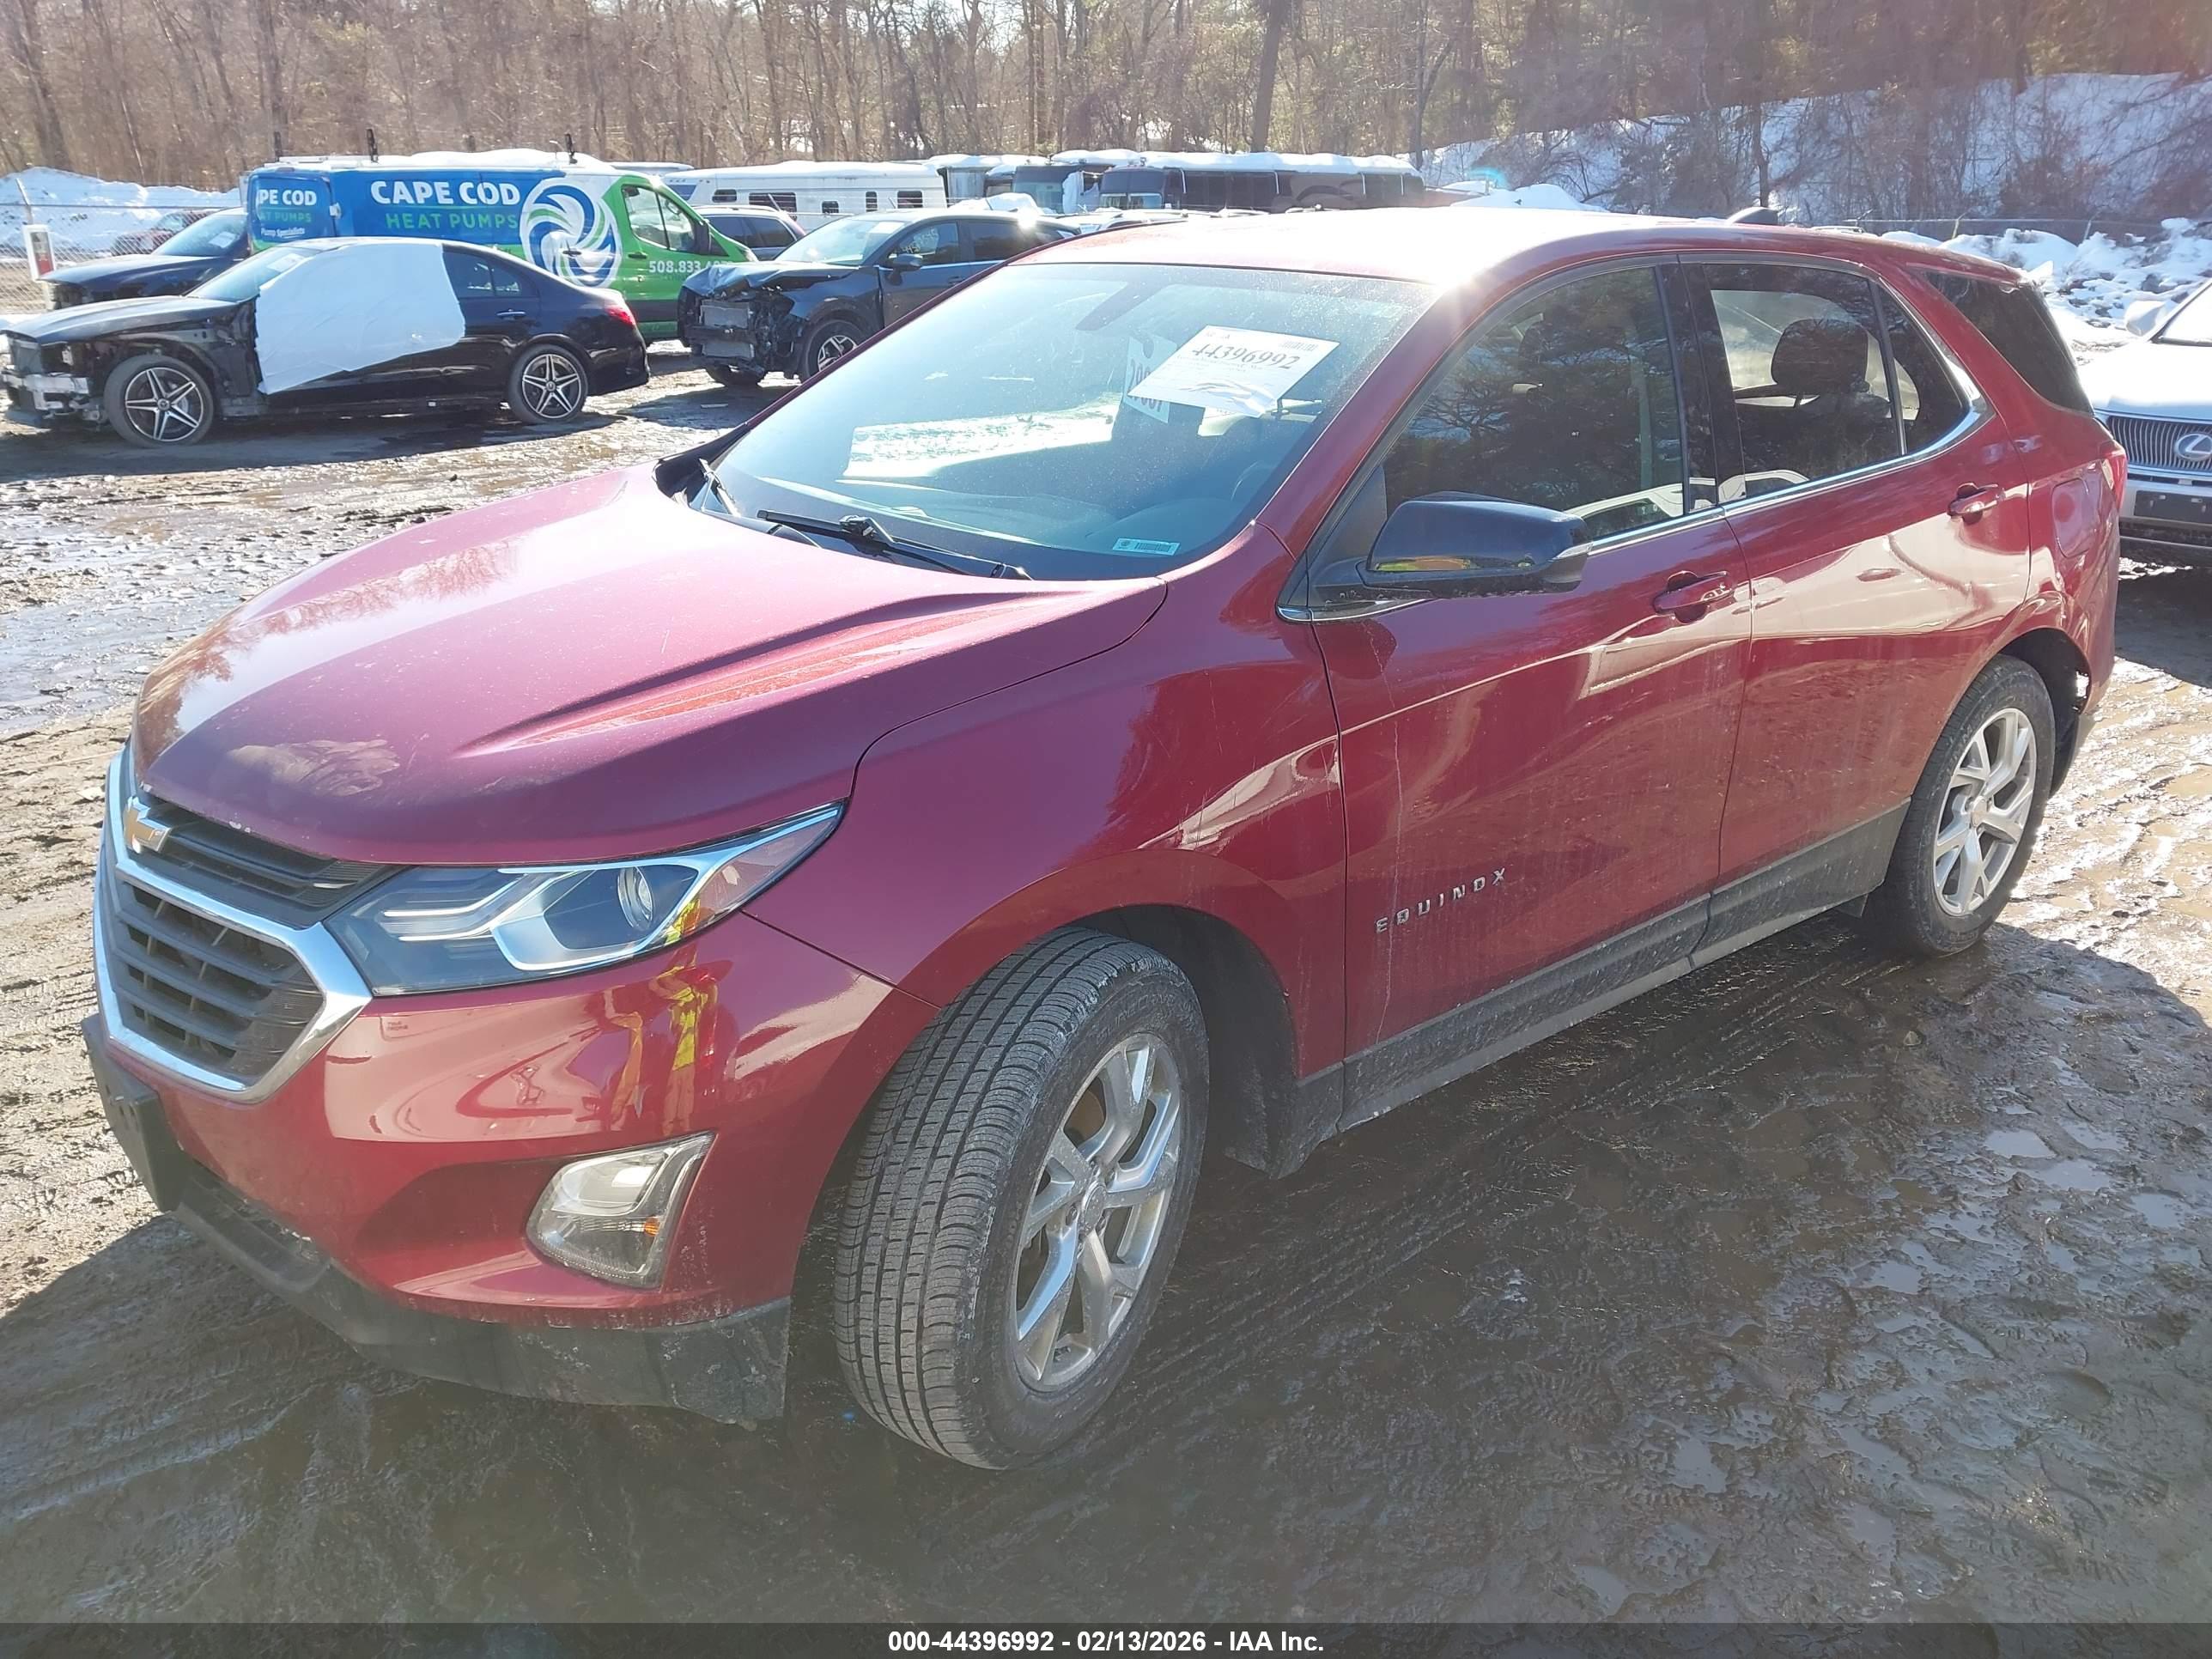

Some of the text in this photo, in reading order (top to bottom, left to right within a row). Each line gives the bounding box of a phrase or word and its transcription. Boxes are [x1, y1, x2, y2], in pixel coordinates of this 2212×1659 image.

[282, 190, 317, 205] COD
[370, 180, 520, 205] CAPE COD
[275, 212, 312, 222] PUMPS
[385, 212, 519, 229] HEAT PUMPS
[1192, 343, 1301, 370] 44396992
[1375, 867, 1505, 933] EQUINOX
